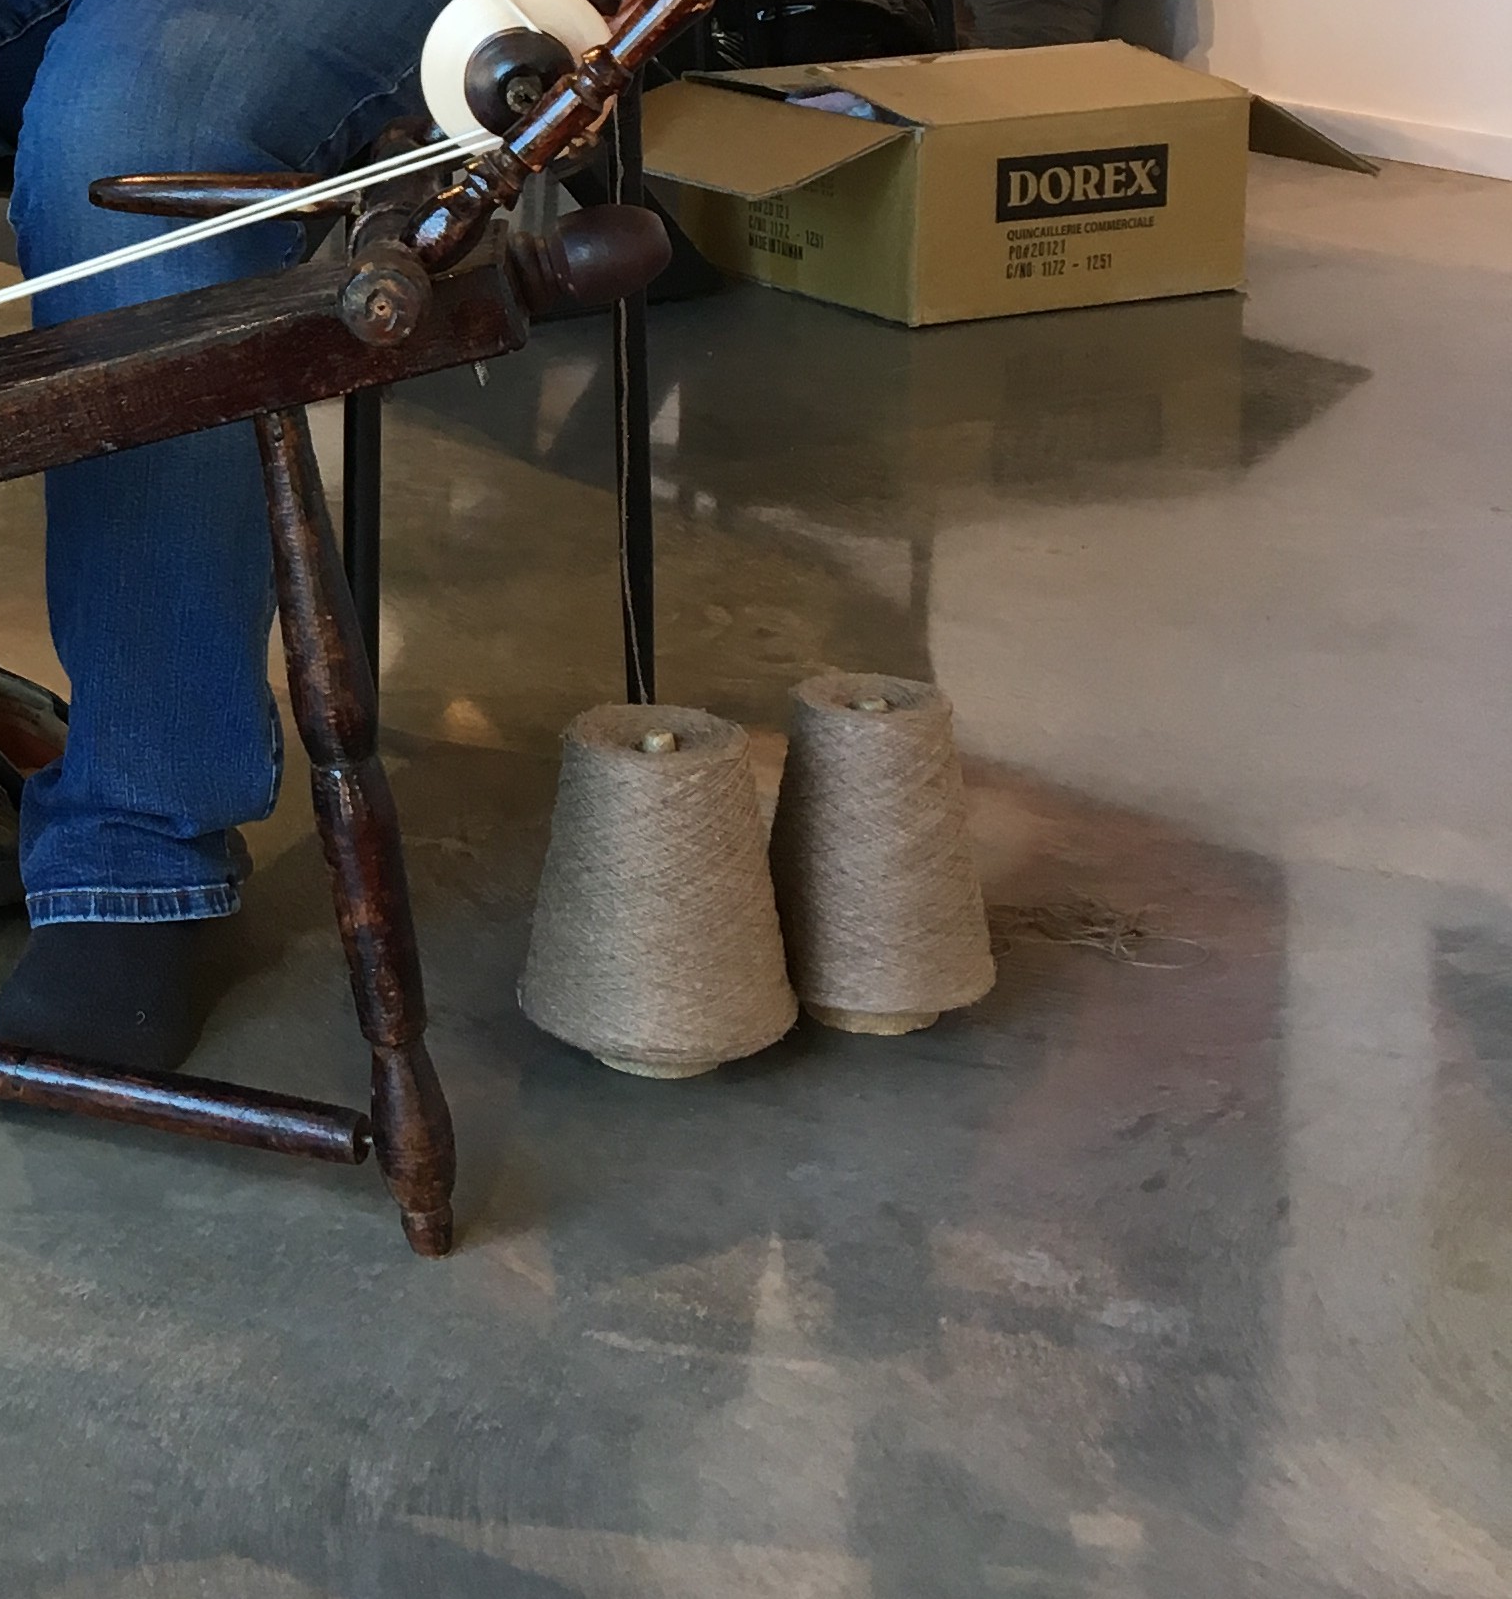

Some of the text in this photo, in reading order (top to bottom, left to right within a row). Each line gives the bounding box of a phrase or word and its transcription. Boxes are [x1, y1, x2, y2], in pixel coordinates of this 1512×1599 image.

[1007, 159, 1157, 207] DOREX
[805, 229, 824, 249] 1251
[1007, 217, 1154, 241] QUINCAILLERIE COMMERCIALE
[1009, 240, 1065, 260] PO#20121
[1041, 259, 1066, 276] 1172
[1086, 253, 1112, 271] 1251
